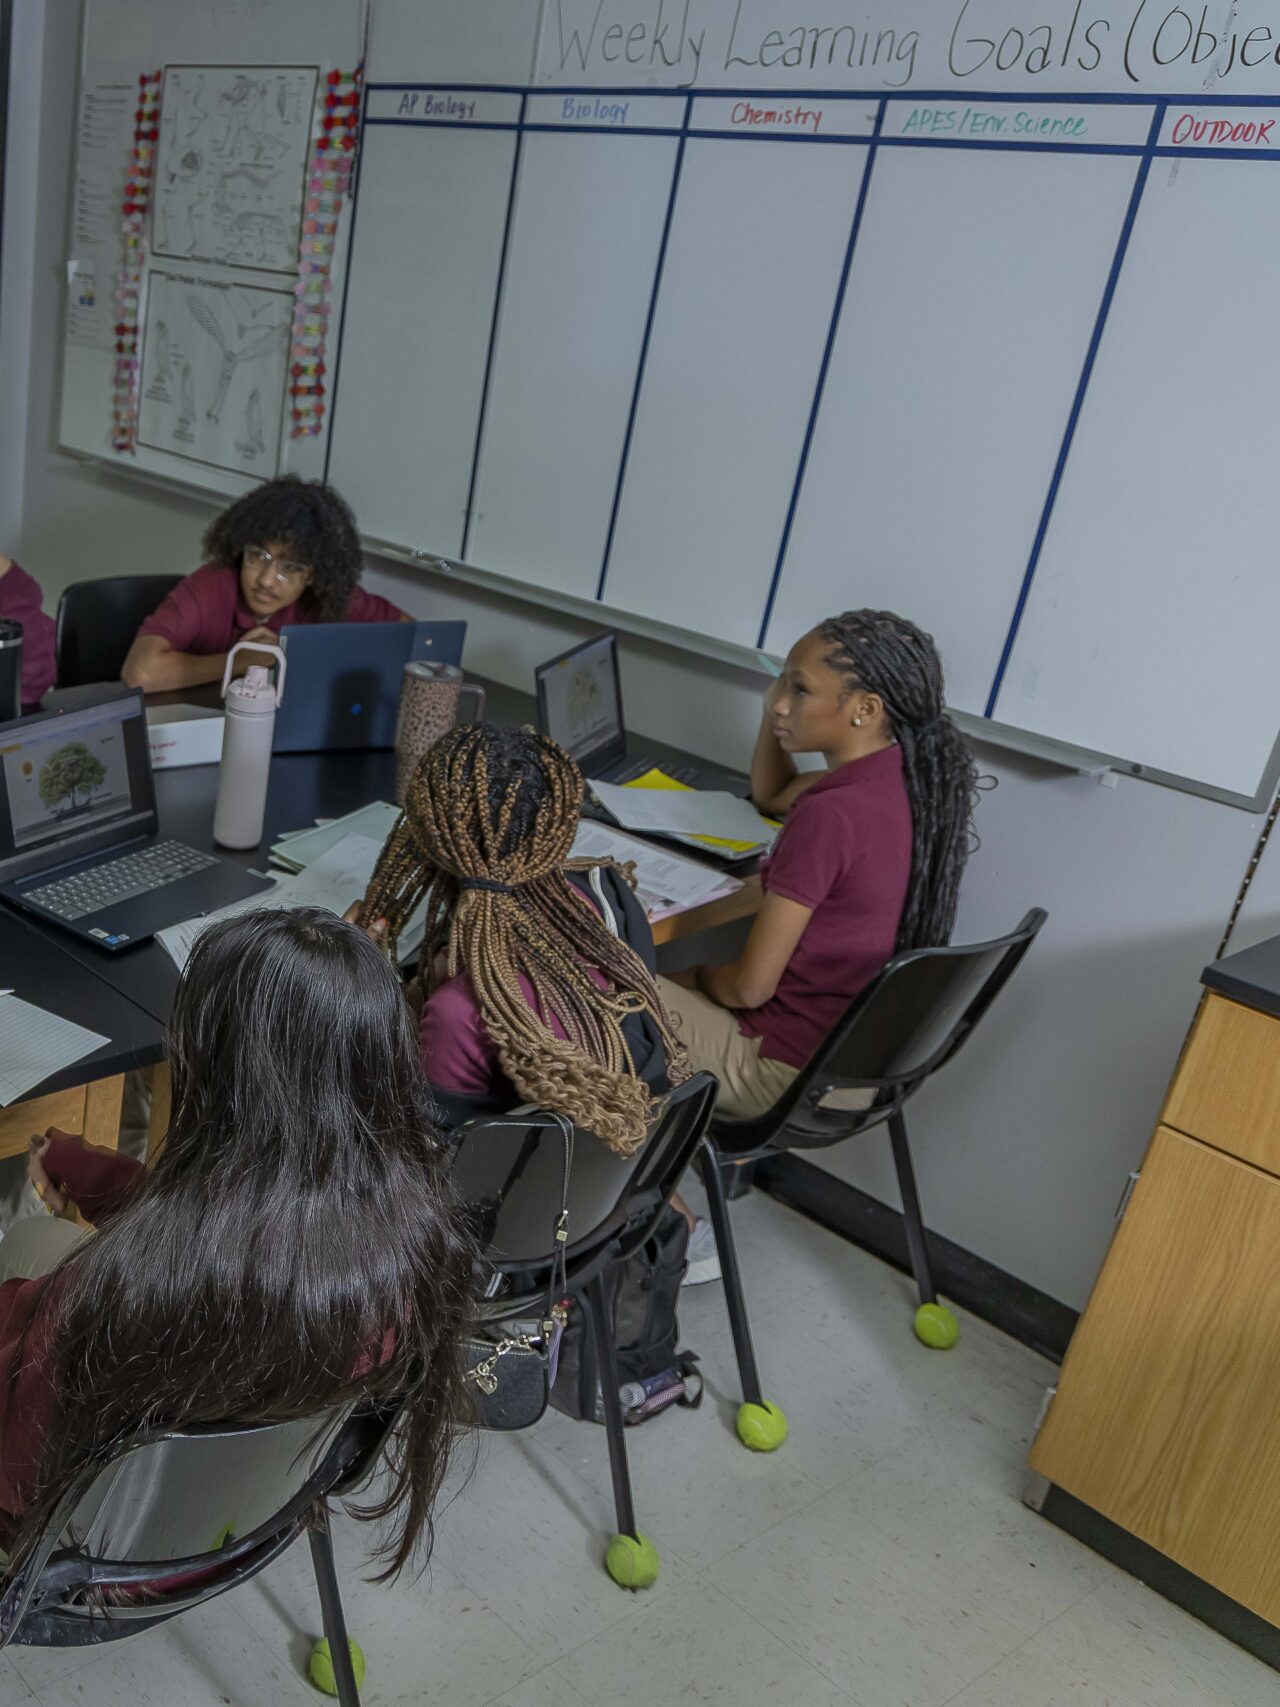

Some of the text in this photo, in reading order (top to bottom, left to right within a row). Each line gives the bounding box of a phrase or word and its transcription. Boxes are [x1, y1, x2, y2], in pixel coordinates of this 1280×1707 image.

[557, 0, 1280, 88] Weekly Learning Goals (Obje
[397, 93, 475, 118] AP Biology
[561, 96, 630, 123] Biology
[730, 102, 824, 133] Chemistry
[1012, 110, 1089, 136] Science
[1172, 114, 1276, 145] OUTDOOR
